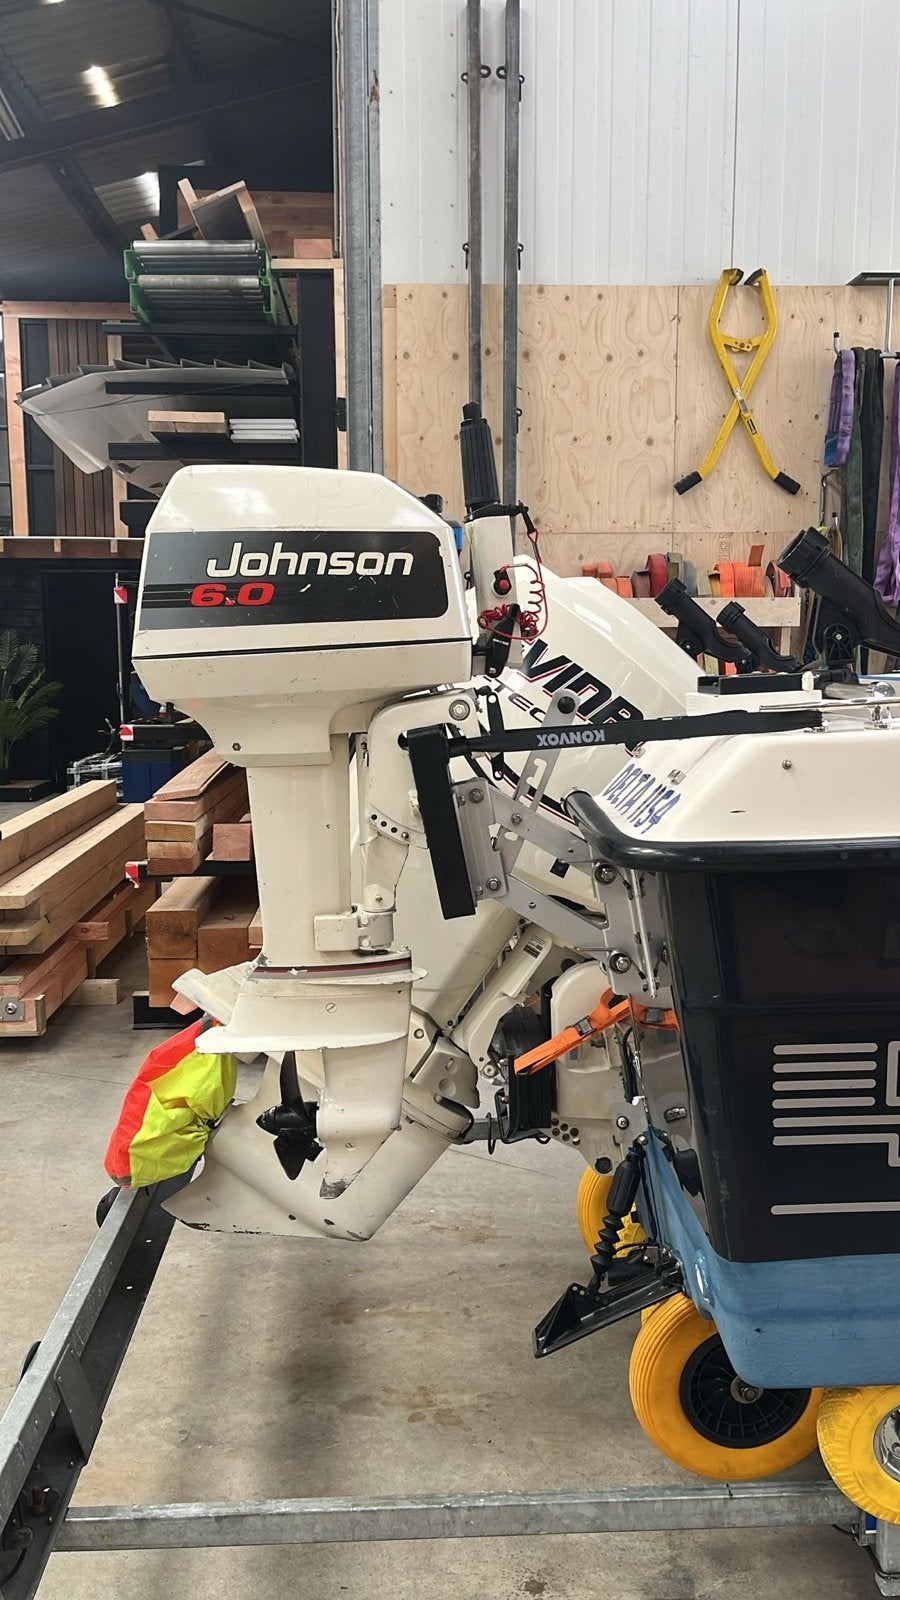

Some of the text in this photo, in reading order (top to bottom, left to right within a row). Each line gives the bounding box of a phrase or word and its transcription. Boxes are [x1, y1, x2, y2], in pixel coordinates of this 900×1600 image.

[206, 541, 414, 578] Johnson
[190, 583, 275, 607] 6.0
[537, 729, 606, 747] KONVOX
[602, 763, 656, 816] DELTA
